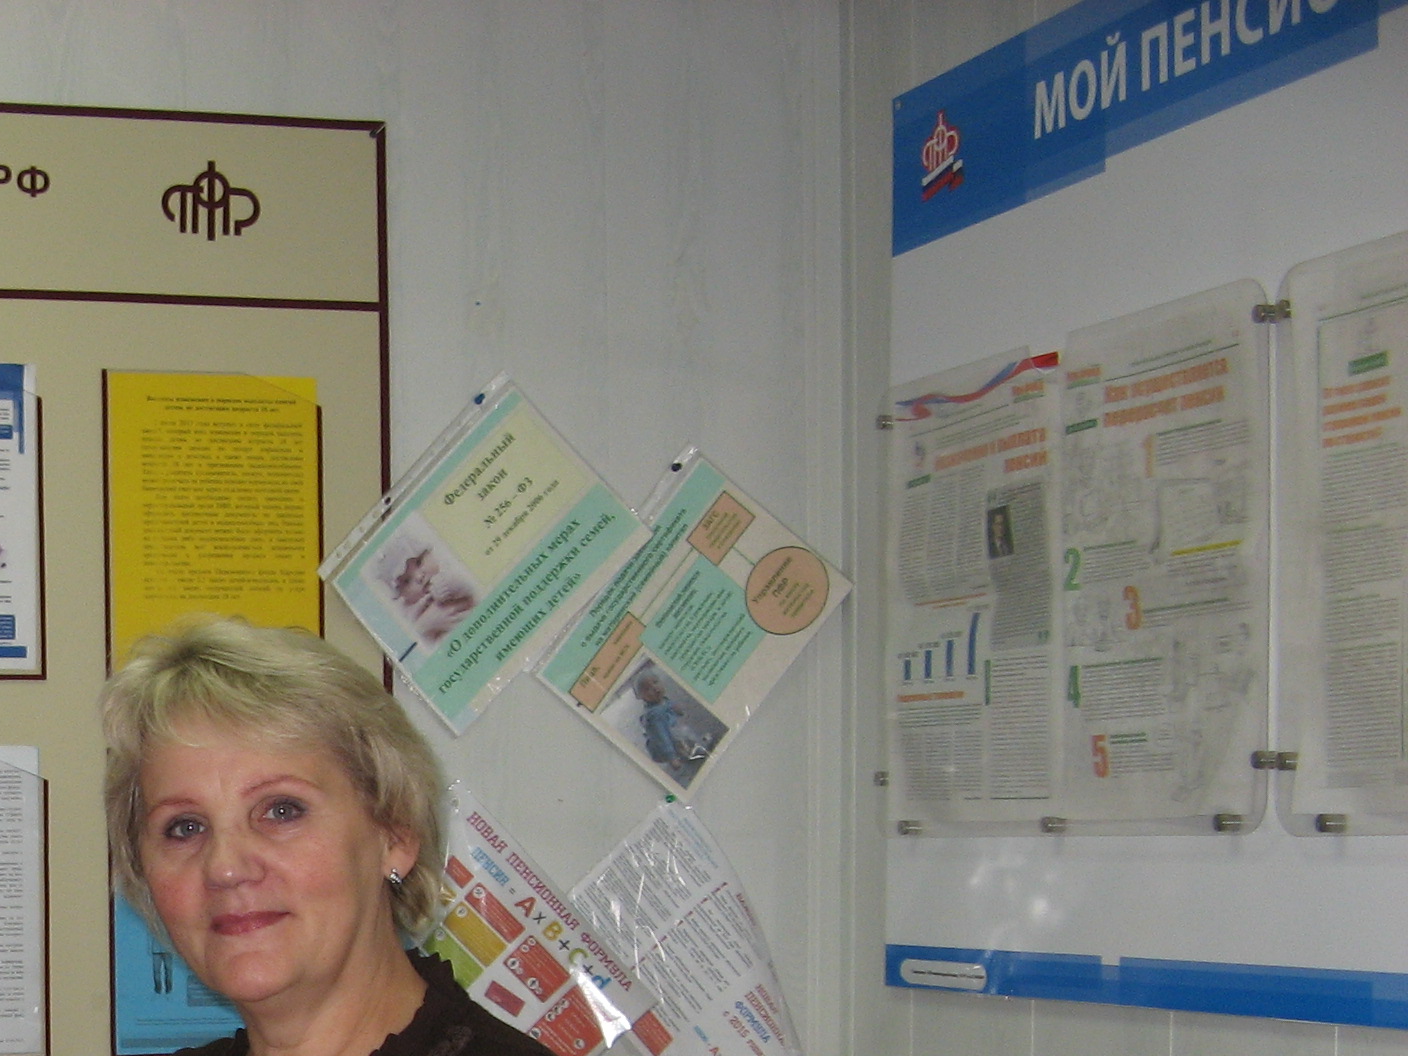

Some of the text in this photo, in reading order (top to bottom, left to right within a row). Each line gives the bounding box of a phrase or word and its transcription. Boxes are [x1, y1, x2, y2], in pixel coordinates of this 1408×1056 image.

[1034, 0, 1337, 139] МОЙ ПЕНСИ
[443, 431, 515, 508] Федеральный
[477, 469, 507, 500] закон
[437, 510, 615, 695] государственной поддержки семей,
[461, 550, 547, 641] дополнительных
[547, 518, 580, 552] мерах
[1064, 548, 1081, 591] 2
[495, 570, 582, 661] имеющих детей»
[1123, 586, 1143, 631] 3
[1067, 665, 1081, 708] 4
[1092, 735, 1110, 778] 5
[468, 812, 634, 990] НОВАЯ ПЕНСИОННАЯ ФОРМУЛА
